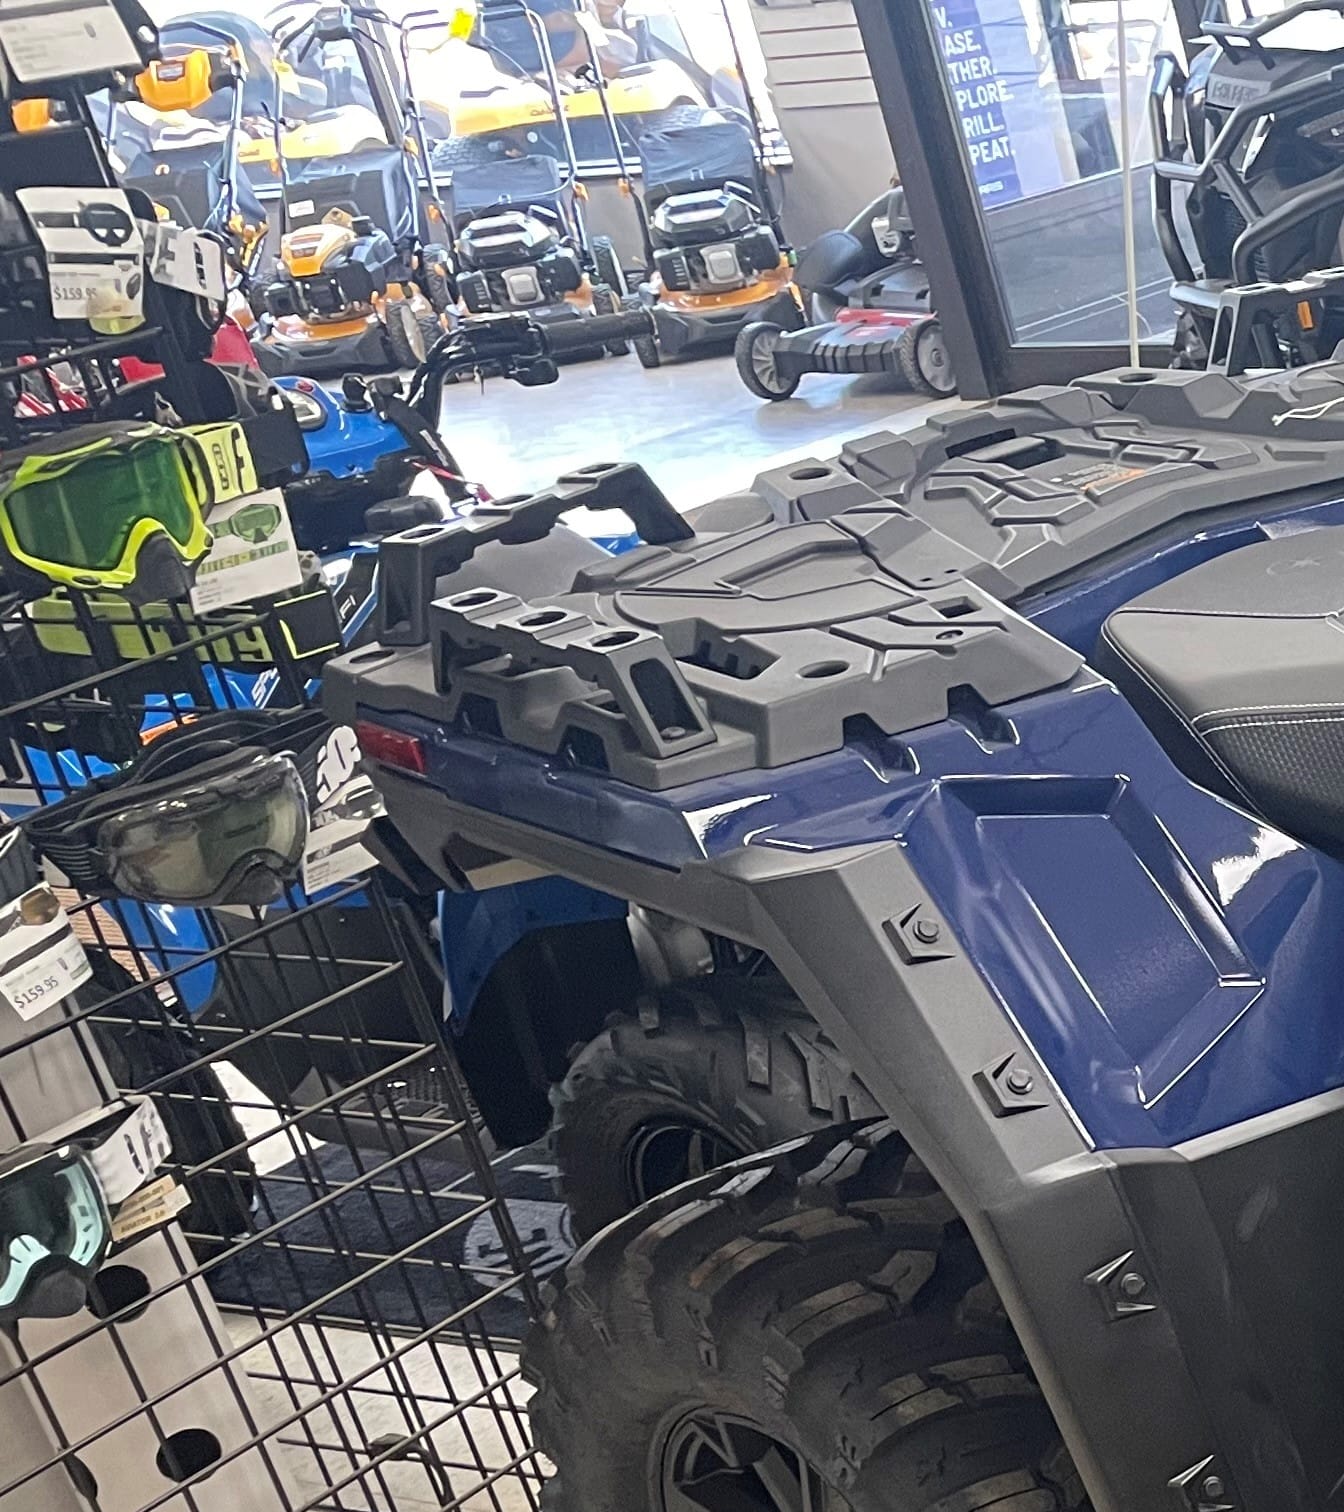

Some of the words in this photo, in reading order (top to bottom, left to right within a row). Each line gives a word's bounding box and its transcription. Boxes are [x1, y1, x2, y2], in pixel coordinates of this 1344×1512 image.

[942, 30, 982, 56] ASE.
[954, 79, 1014, 111] PLORE.
[962, 112, 1005, 138] RILL.
[968, 136, 1016, 166] PEAT.
